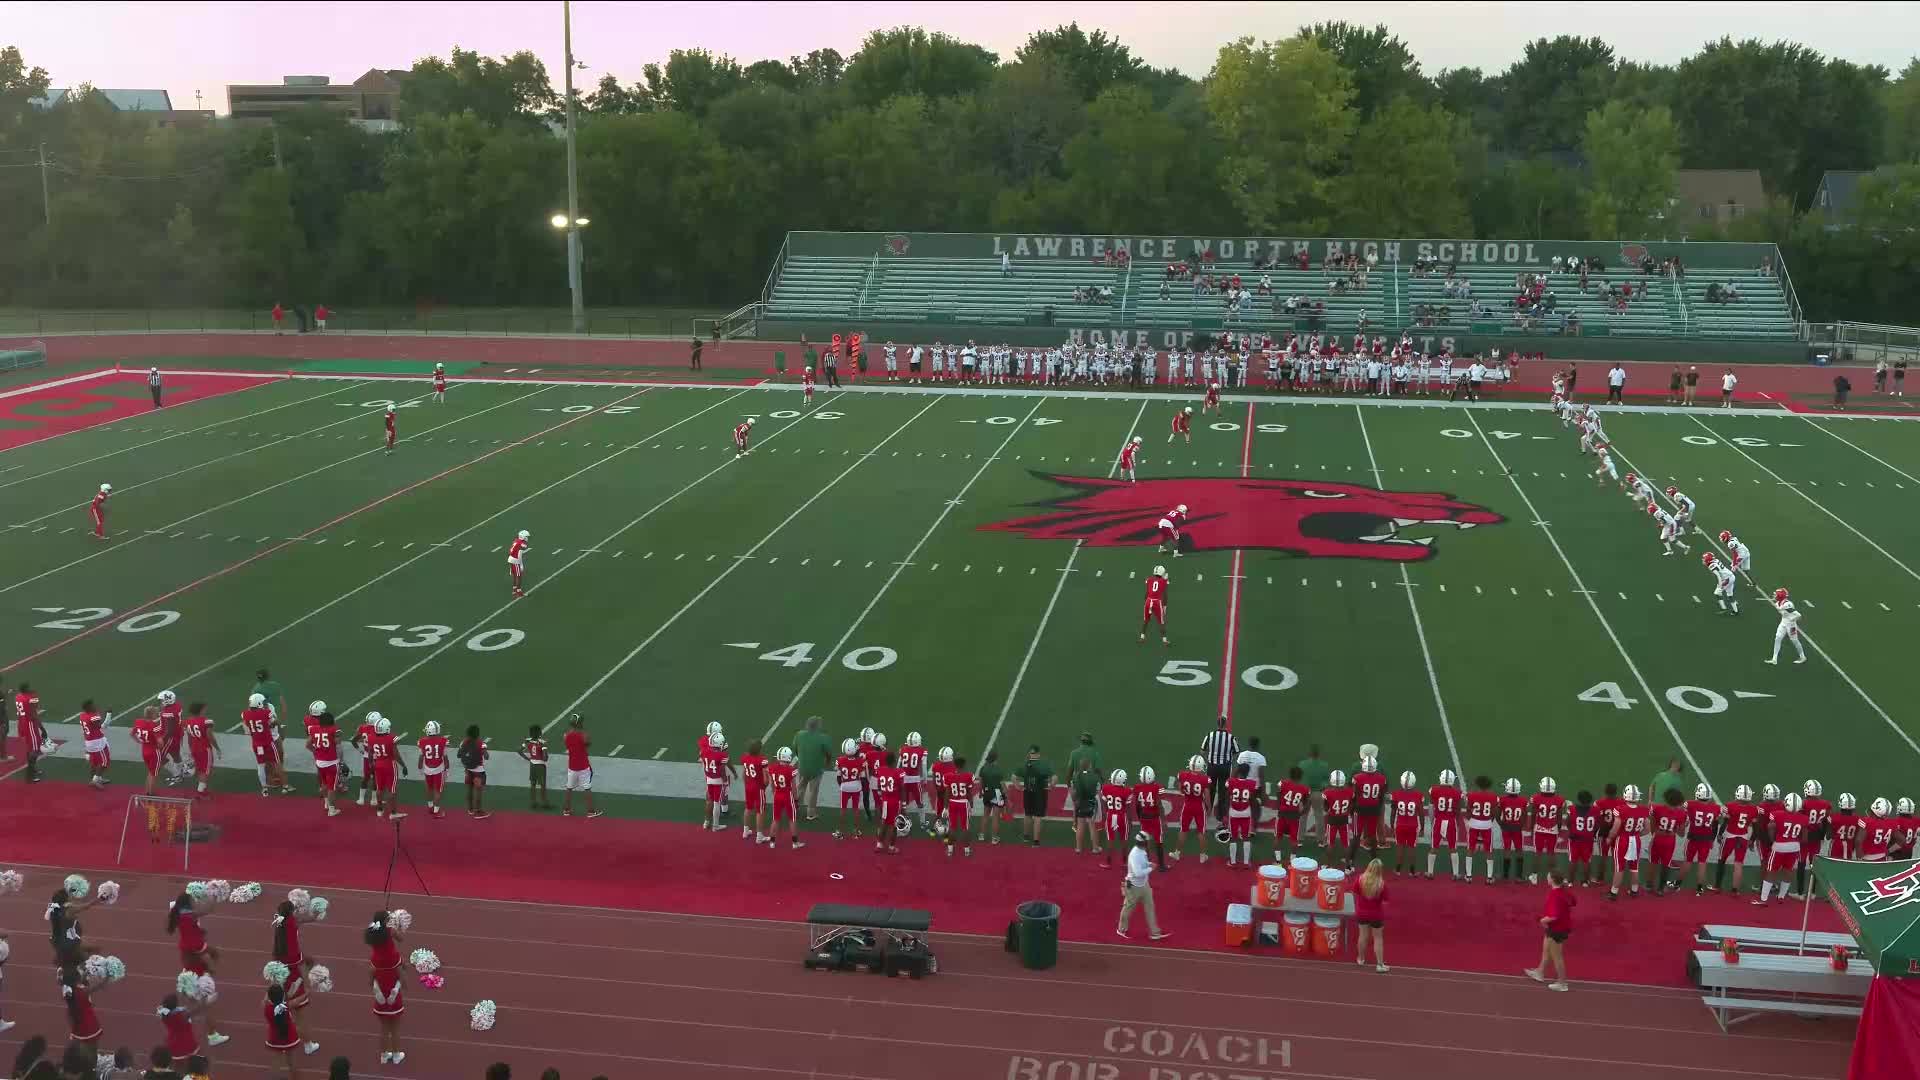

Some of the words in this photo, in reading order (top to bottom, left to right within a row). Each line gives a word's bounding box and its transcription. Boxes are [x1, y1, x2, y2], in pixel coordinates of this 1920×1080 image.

[993, 236, 1176, 258] LAWRENCE
[1418, 243, 1540, 263] SCHOOL
[1164, 331, 1194, 348] OF
[32, 607, 181, 632] 20
[388, 624, 526, 652] 30
[758, 642, 899, 671] 40
[1155, 660, 1299, 691] 50
[1577, 681, 1729, 714] 40
[249, 719, 264, 733] 15
[425, 745, 439, 760] 21
[902, 752, 918, 769] 20
[880, 775, 894, 792] 23
[951, 783, 967, 797] 85
[1184, 781, 1201, 797] 39
[1363, 783, 1380, 799] 90
[1106, 795, 1122, 810] 26
[1138, 792, 1154, 807] 44
[1232, 788, 1250, 803] 29
[1333, 800, 1349, 815] 42
[1438, 796, 1453, 812] 81
[1472, 802, 1491, 817] 28
[1737, 813, 1748, 829] 5
[1783, 822, 1801, 839] 70
[1103, 1026, 1292, 1067] COACH
